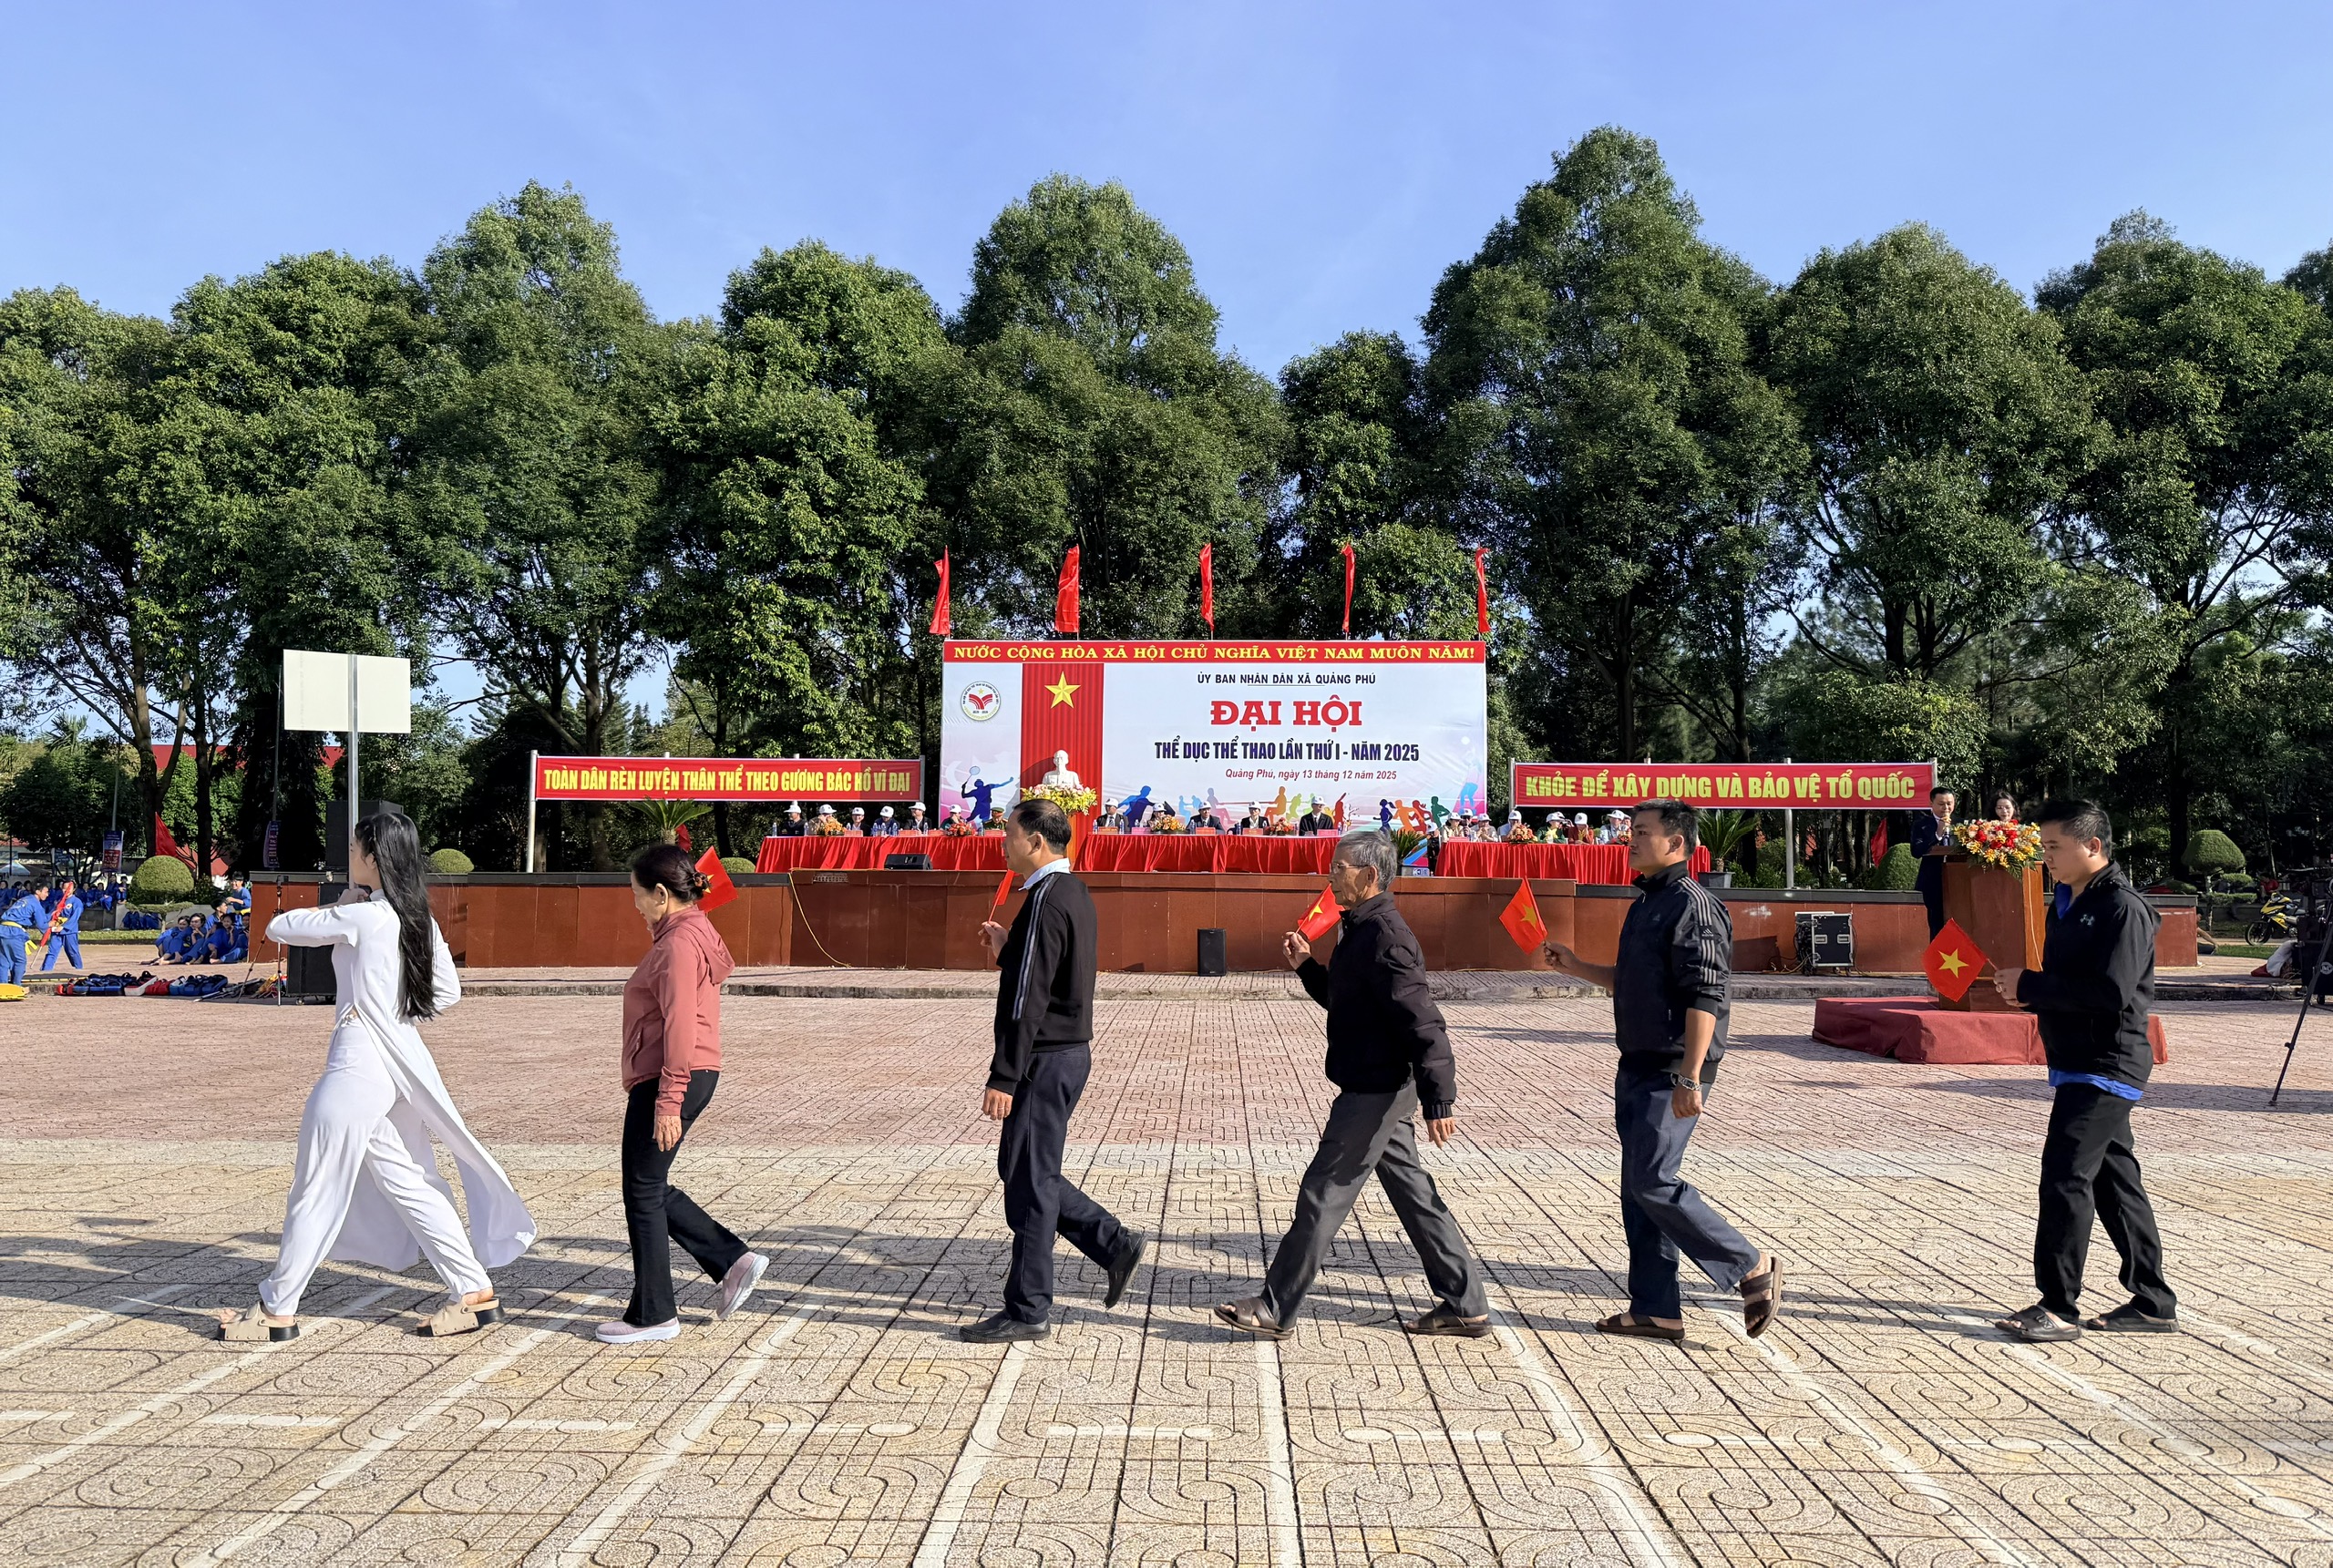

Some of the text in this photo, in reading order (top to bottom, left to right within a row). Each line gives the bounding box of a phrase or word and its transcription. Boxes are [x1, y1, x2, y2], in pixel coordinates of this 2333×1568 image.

[954, 643, 1475, 661] NƯỚC CỘNG HÒA XÃ HỘI CHỦ NGHĨA VIỆT NAM MUÔN NĂM!
[1197, 671, 1376, 684] ỦY BAN NHÂN DÂN XÃ QUẢNG PHÚ
[1210, 694, 1362, 733] ĐẠI HỘI
[1155, 735, 1180, 759] THỂ
[1184, 742, 1210, 763] DỤC
[1213, 735, 1239, 759] THỂ
[1241, 743, 1276, 760] THAO
[1279, 738, 1303, 760] LẦN
[1306, 740, 1334, 760] THỨ
[1335, 743, 1341, 761] I
[1351, 741, 1381, 761] NĂM
[1384, 743, 1420, 762] 2025
[544, 764, 910, 795] TOÀN DÂN RÈN LUYỆN THÂN THỂ THEO GƯƠNG BÁC HỒ VĨ ĐẠI
[1225, 768, 1397, 781] Quảng Phú, ngày 13 tháng 12 năm 2025
[1526, 769, 1915, 802] KHỎE ĐỂ XÂY DỰNG VÀ BẢO VỆ TỔ QUỐC
